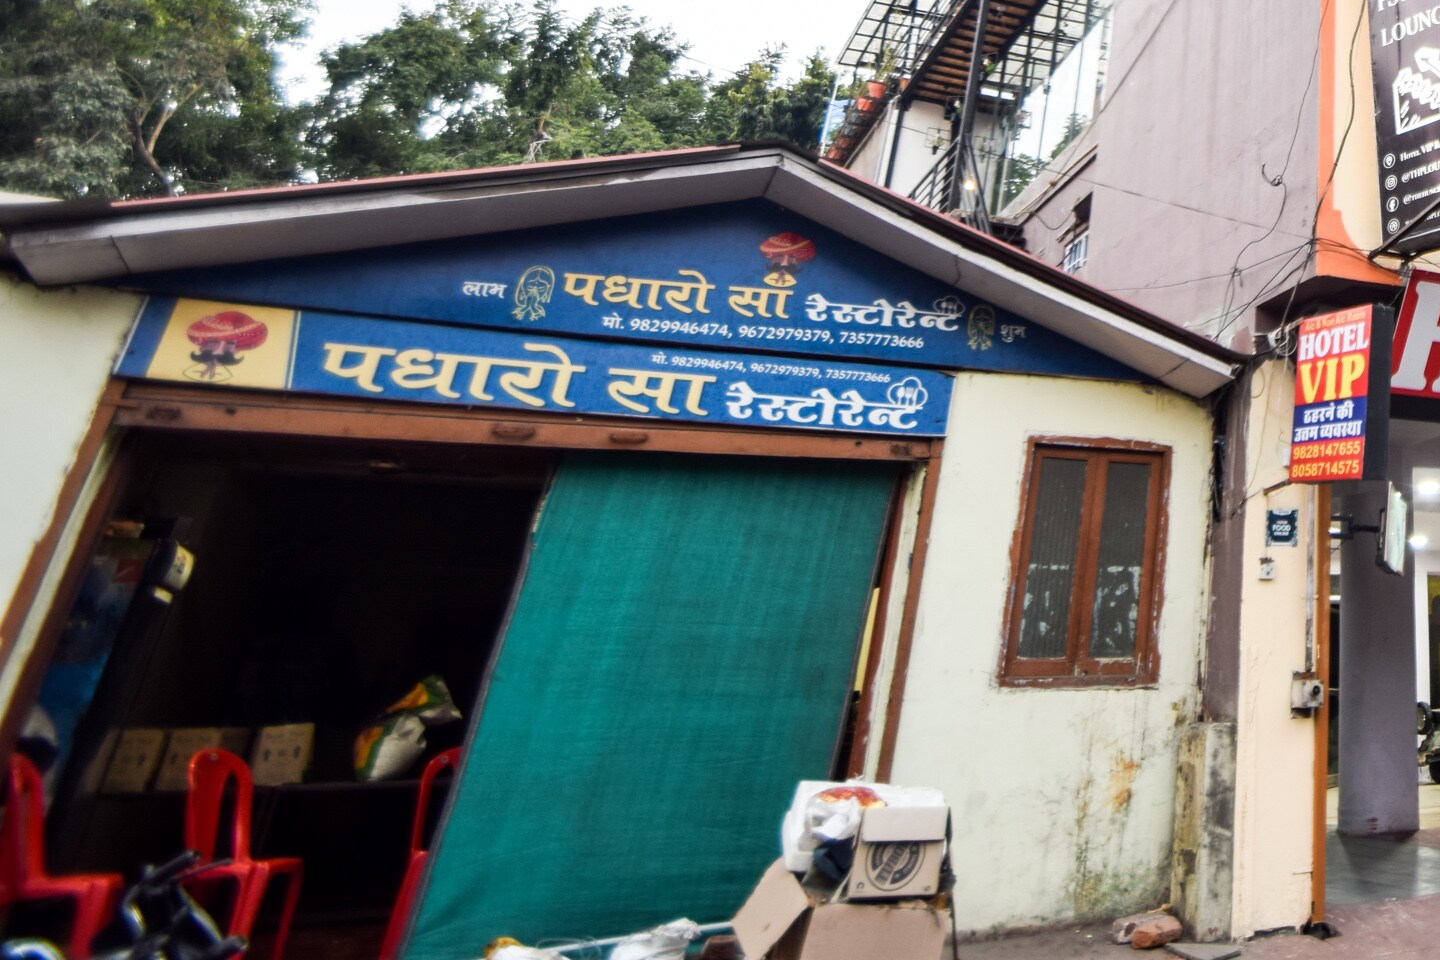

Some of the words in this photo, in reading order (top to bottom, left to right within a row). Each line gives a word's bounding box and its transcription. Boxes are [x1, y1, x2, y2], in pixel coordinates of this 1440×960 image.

[563, 270, 716, 315] पधारो
[630, 317, 733, 339] 9829946474,
[738, 325, 834, 344] 9672979379,
[839, 330, 925, 349] 7357773666
[1298, 321, 1370, 363] HOTEL
[323, 342, 586, 408] पधारो
[607, 366, 717, 416] सा
[671, 355, 747, 373] 9829946474,
[750, 362, 823, 379] 9672979379,
[825, 368, 892, 383] 7357773666
[1299, 354, 1366, 404] VIP
[1303, 402, 1335, 424] ठहरने
[1336, 399, 1355, 420] की
[1294, 426, 1319, 442] उत्तम
[1320, 420, 1363, 439] व्यवस्था
[1293, 440, 1361, 460] 9828147655
[1291, 459, 1360, 478] 8058714575
